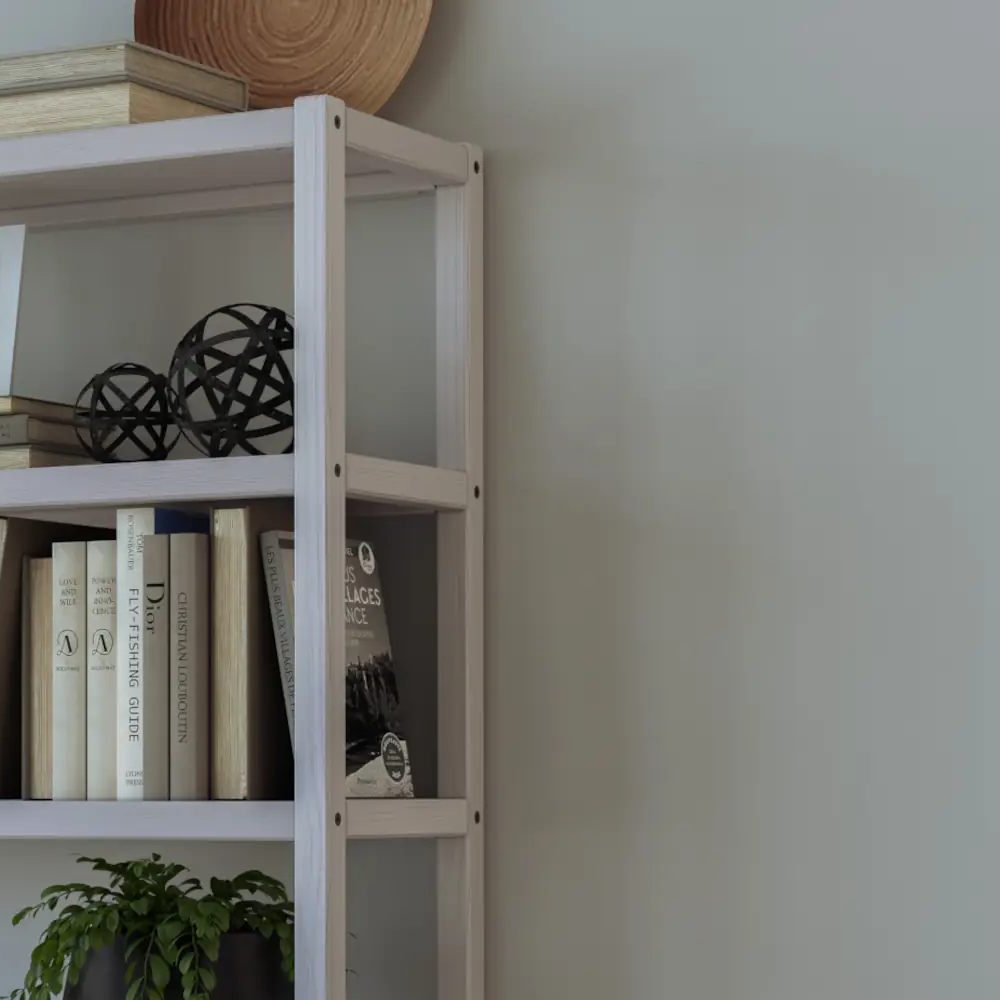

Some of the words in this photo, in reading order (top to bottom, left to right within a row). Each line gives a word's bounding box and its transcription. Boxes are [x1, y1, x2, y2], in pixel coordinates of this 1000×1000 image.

[61, 588, 77, 596] AND
[95, 587, 112, 595] AND
[145, 583, 165, 635] Dior
[128, 588, 139, 688] FLY-FISHING
[177, 591, 188, 661] CHRISTIAN
[128, 696, 140, 742] GUIDE
[177, 666, 188, 744] LOUBOUTIN
